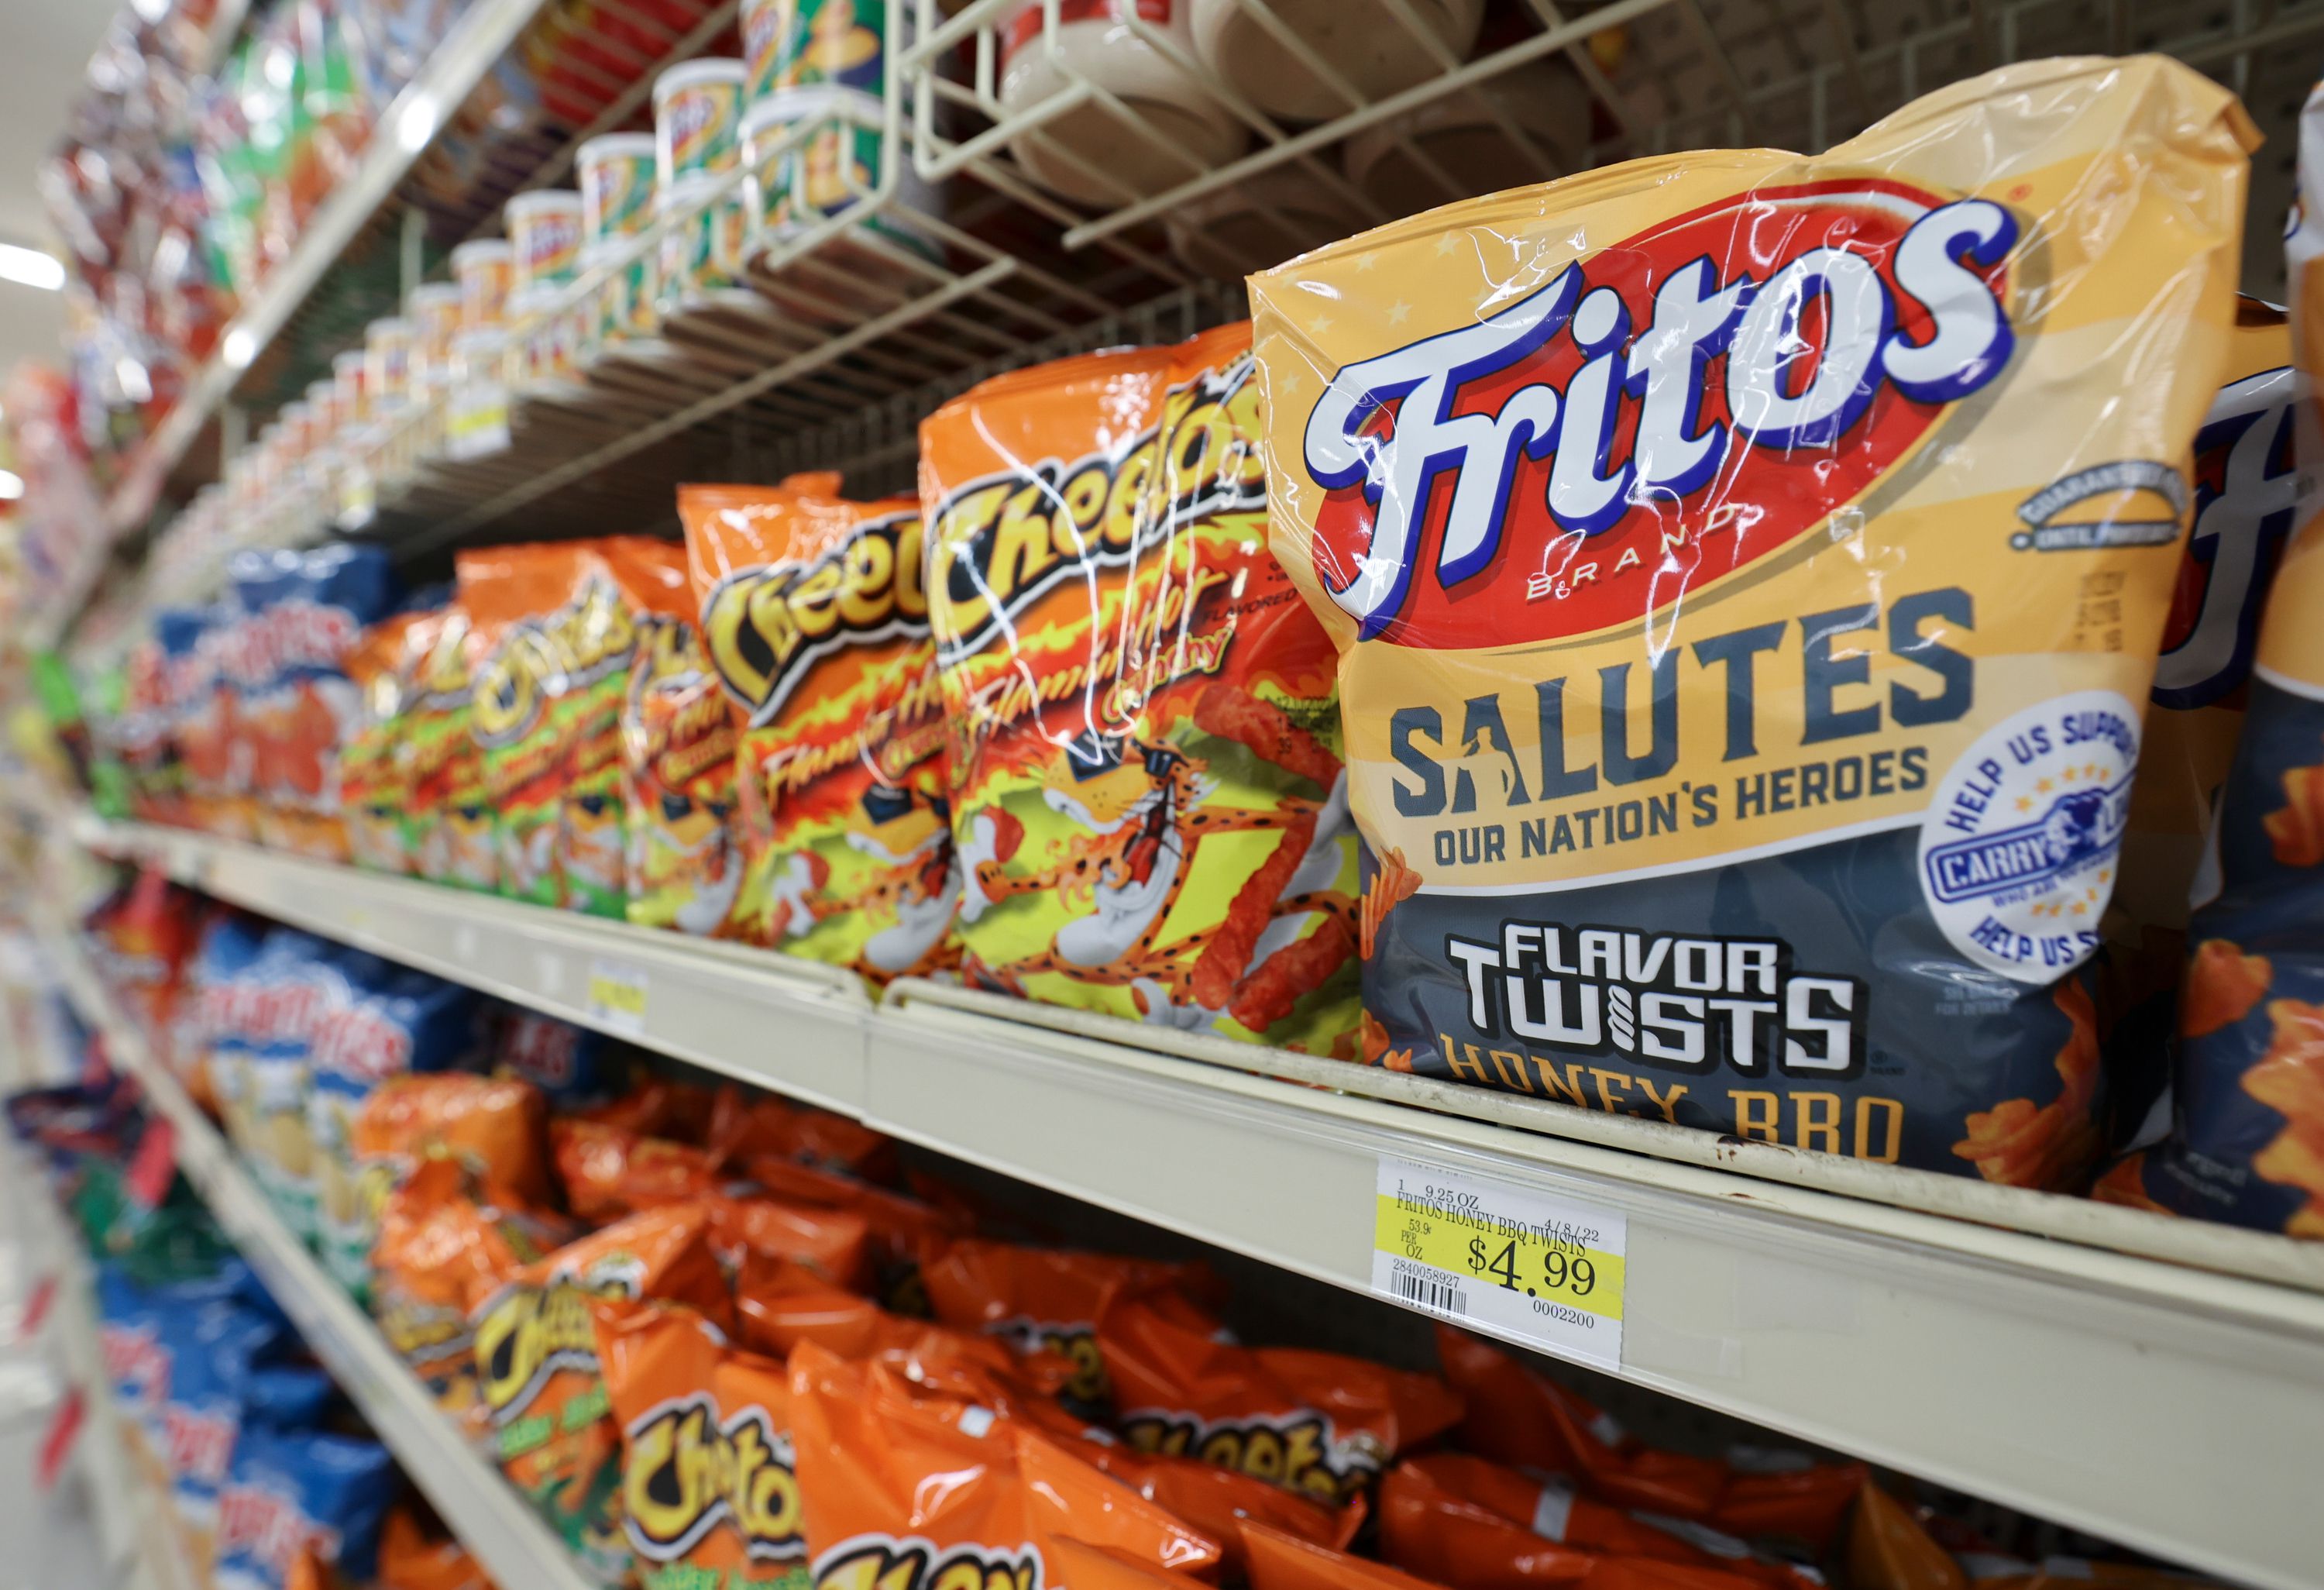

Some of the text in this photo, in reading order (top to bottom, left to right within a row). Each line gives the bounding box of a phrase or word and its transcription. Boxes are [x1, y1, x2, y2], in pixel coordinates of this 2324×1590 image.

[1304, 198, 2018, 642] Fritos
[1527, 504, 1735, 602] BRAND
[1390, 586, 1975, 818] SALUTES
[1435, 746, 1929, 866] OUR NATION'S HEROES
[1946, 759, 2003, 833] HELP
[2007, 726, 2052, 766] US
[1940, 831, 2054, 890] CARRY
[1504, 925, 1779, 994] FLAVOR
[1970, 916, 2033, 963] HELP
[2040, 937, 2075, 967] US
[1449, 939, 1855, 1072] TWISTS
[1440, 1032, 1689, 1124] HONEY
[1397, 1191, 1586, 1258] FRITOS HONEY BBQ TWISTS
[1425, 1186, 1453, 1203] 9.25
[1458, 1192, 1479, 1210] OZ
[1401, 1230, 1416, 1245] PER
[1406, 1244, 1423, 1261] OZ
[1467, 1235, 1596, 1298] $4.99
[1393, 1258, 1459, 1289] 2840058927
[1533, 1300, 1594, 1330] 0002200
